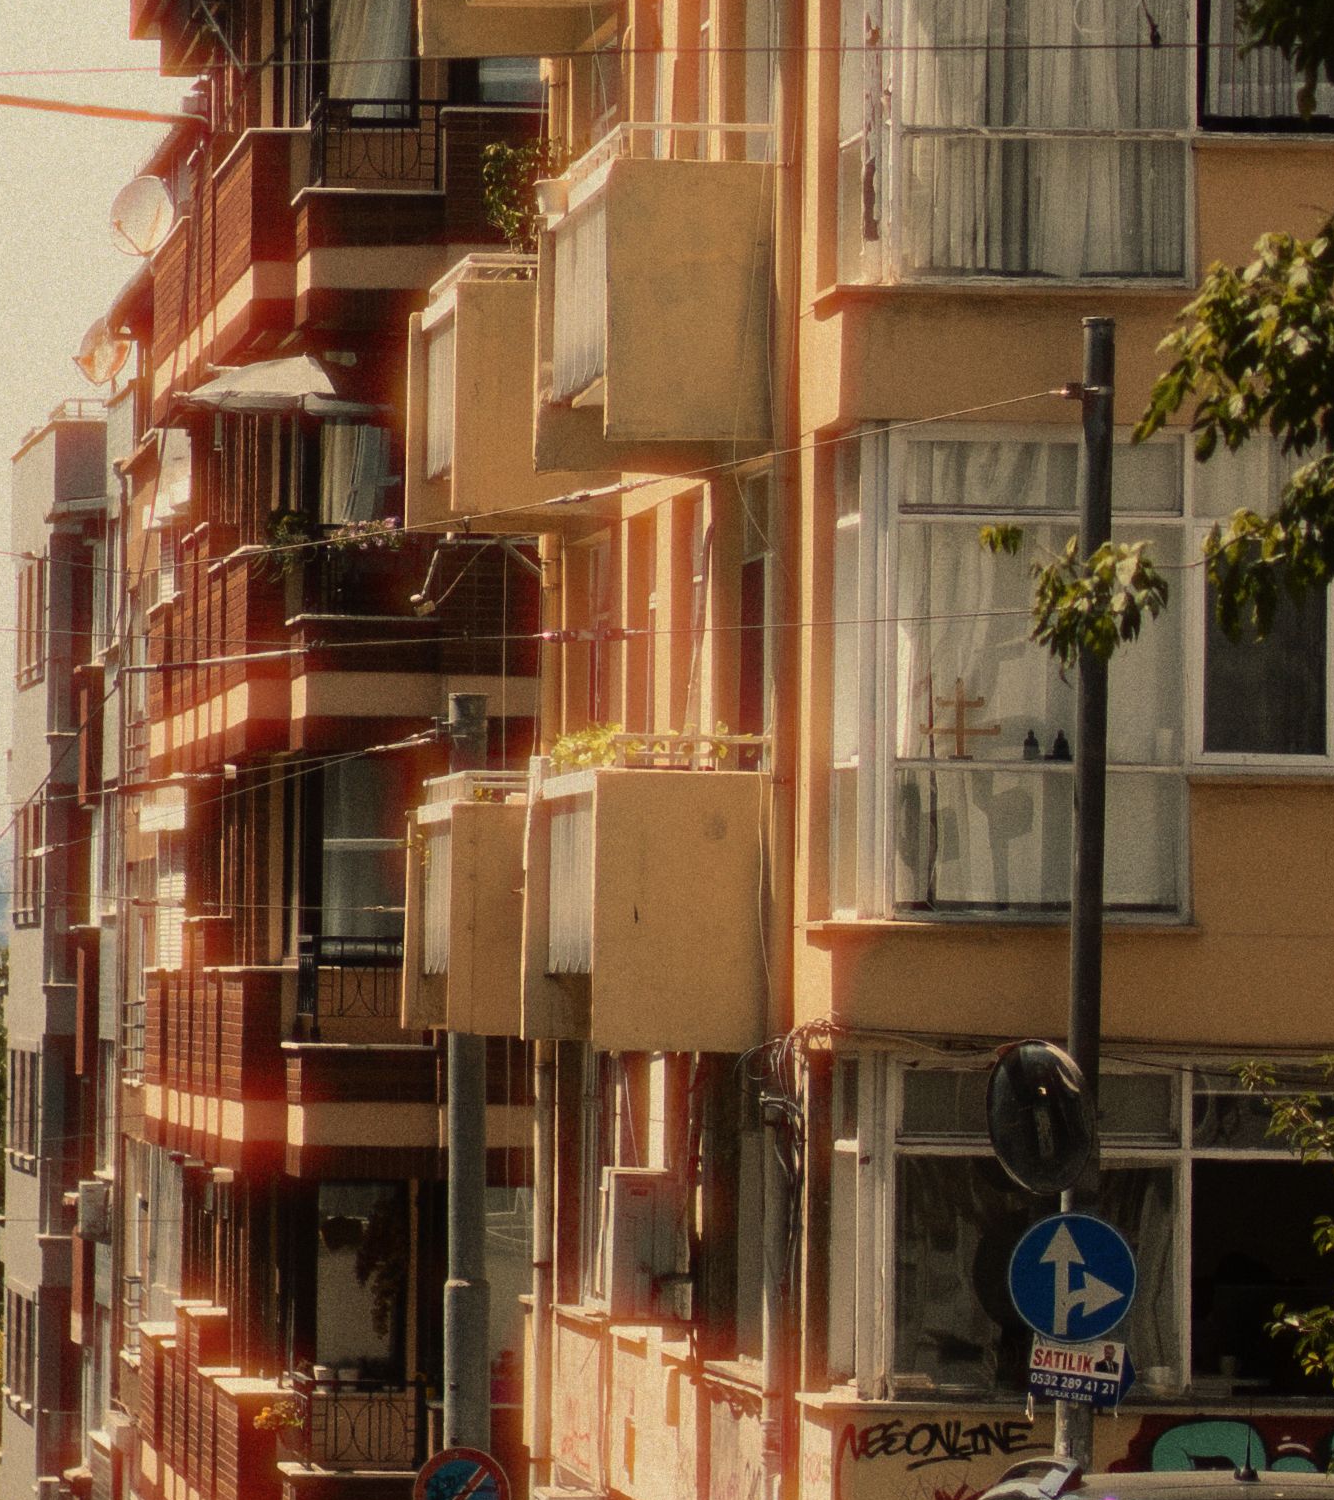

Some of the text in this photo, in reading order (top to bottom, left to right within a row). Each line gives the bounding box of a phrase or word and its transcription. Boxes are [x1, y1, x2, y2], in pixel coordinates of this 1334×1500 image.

[1033, 1348, 1094, 1373] SATILIK
[1030, 1372, 1115, 1395] 0532 289 41 21
